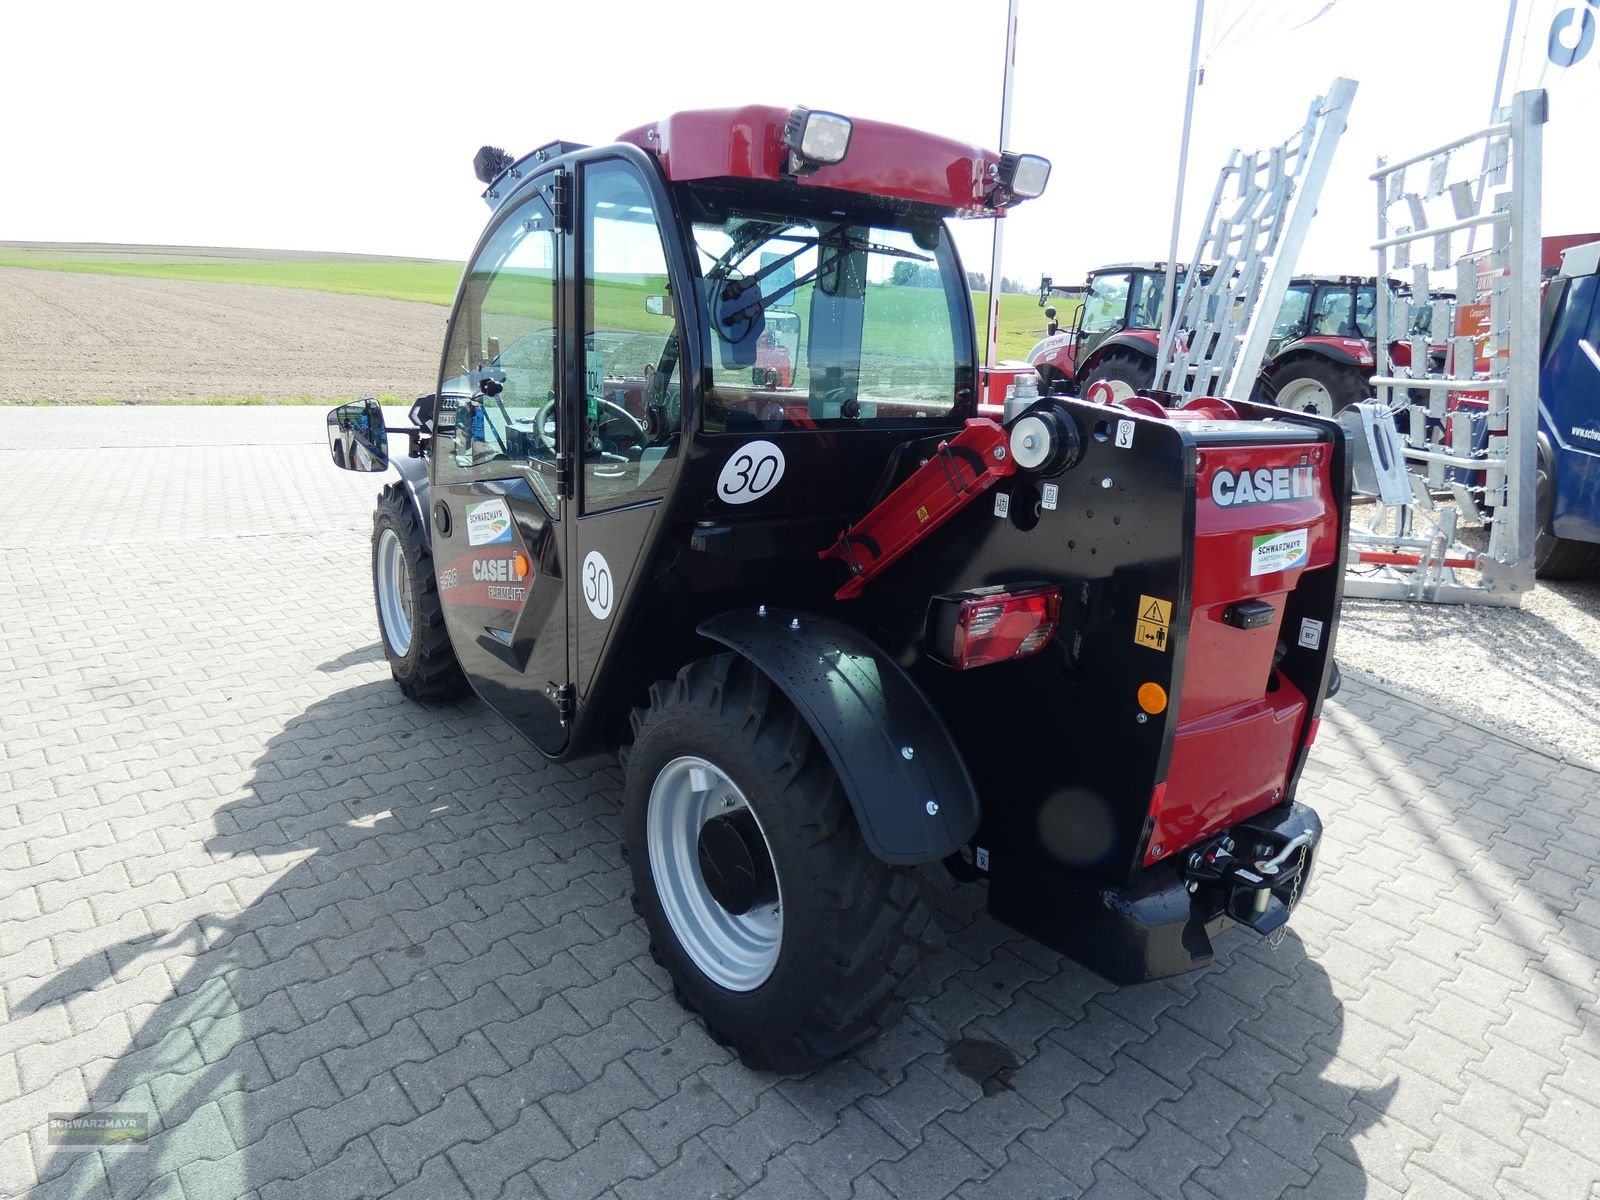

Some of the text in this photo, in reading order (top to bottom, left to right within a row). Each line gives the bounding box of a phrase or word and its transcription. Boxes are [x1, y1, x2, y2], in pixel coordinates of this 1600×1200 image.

[1046, 337, 1064, 348] STEYR
[723, 454, 778, 495] 30
[1211, 467, 1291, 506] CASE
[470, 509, 503, 524] SCHWARZMAYR
[1258, 540, 1300, 555] SCHWARZMAYR
[472, 559, 507, 581] CASE
[488, 585, 526, 602] FARMLIFT
[586, 561, 609, 610] 30
